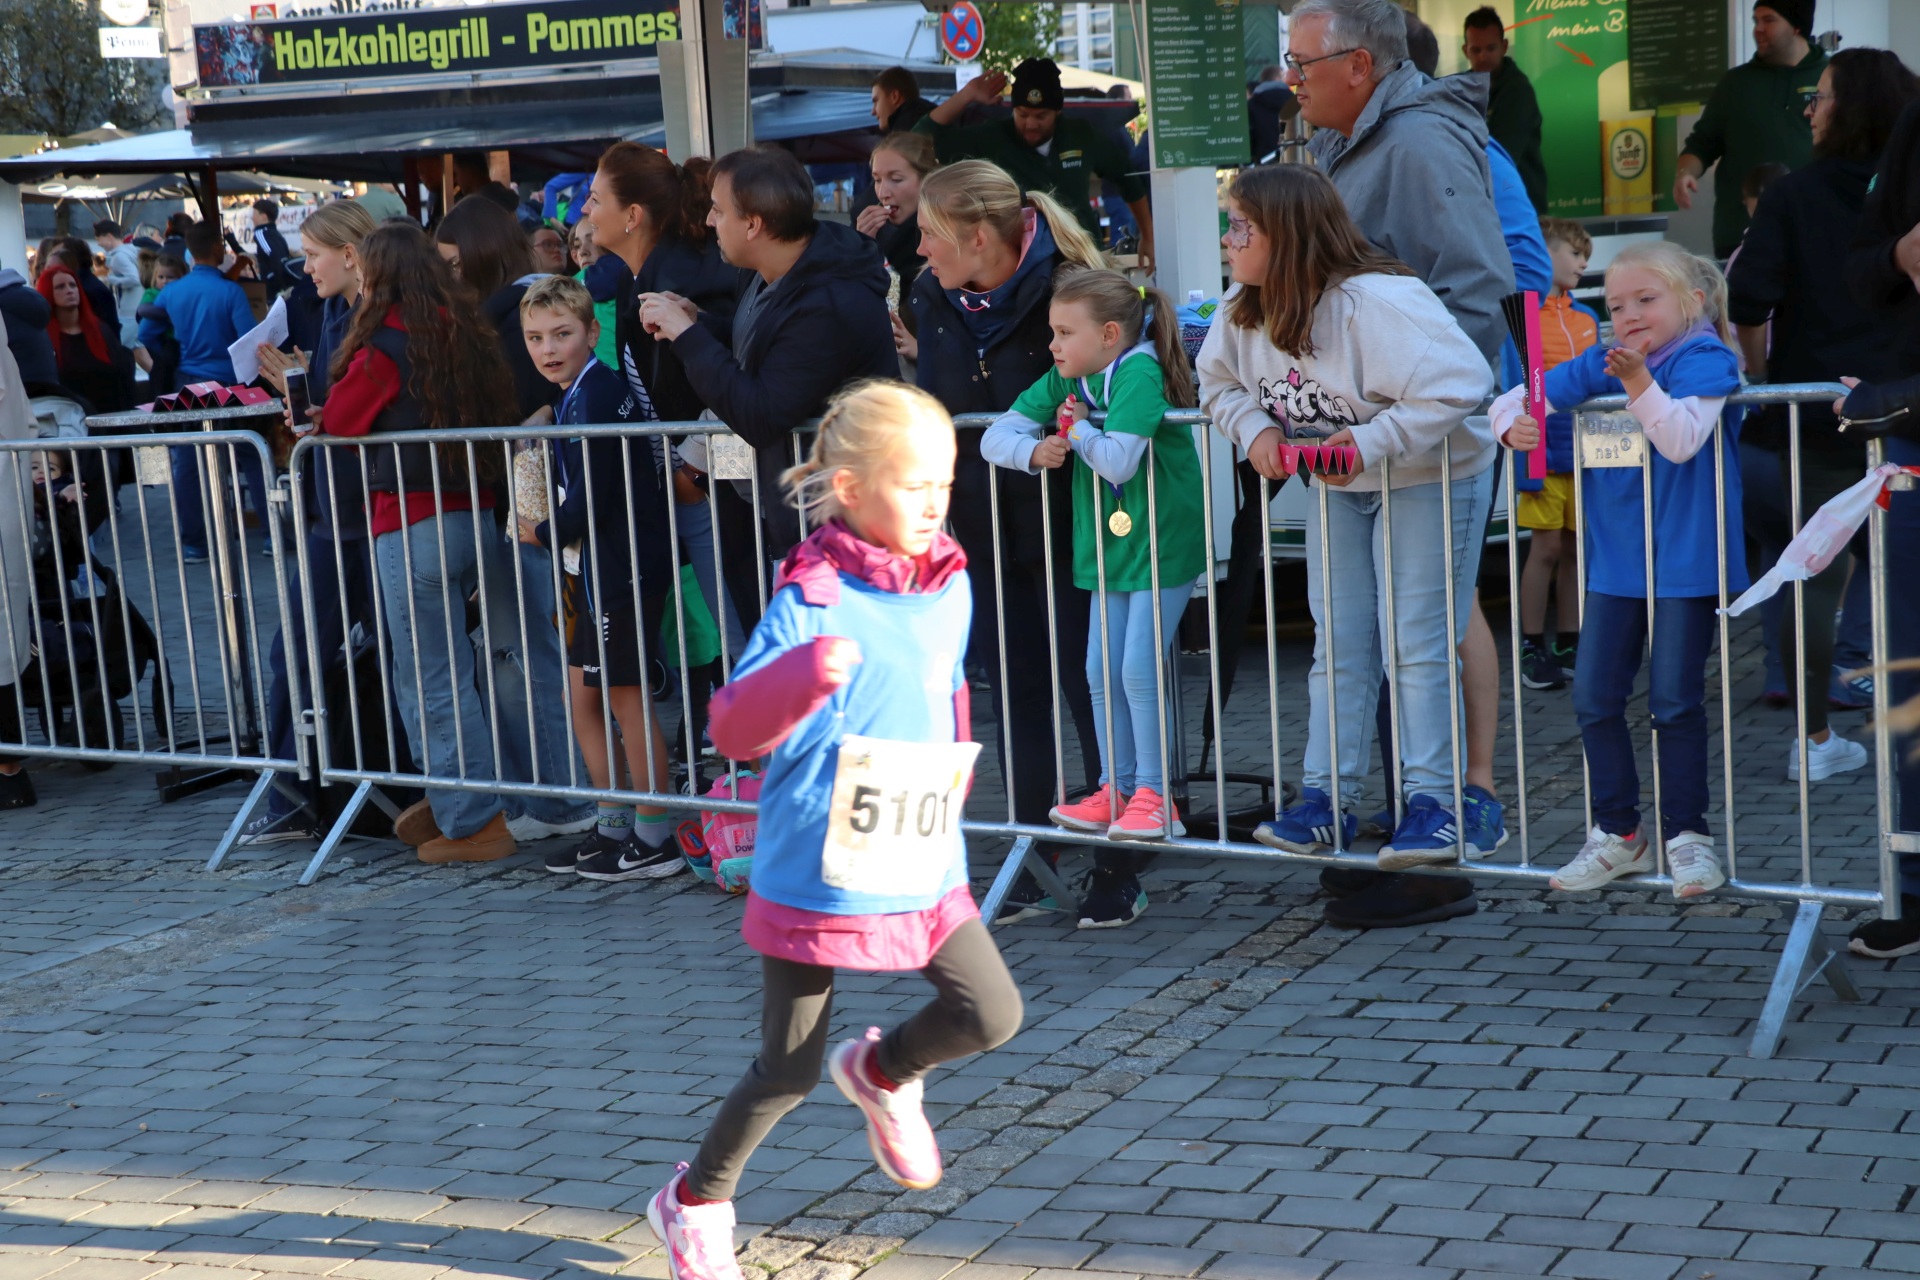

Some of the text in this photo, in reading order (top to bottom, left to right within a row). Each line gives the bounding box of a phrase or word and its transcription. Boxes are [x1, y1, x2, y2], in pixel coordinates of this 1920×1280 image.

[273, 17, 490, 71] Holzkohlegrill
[527, 11, 678, 54] Pommes
[1533, 367, 1541, 403] VOSS
[849, 784, 949, 838] 5101
